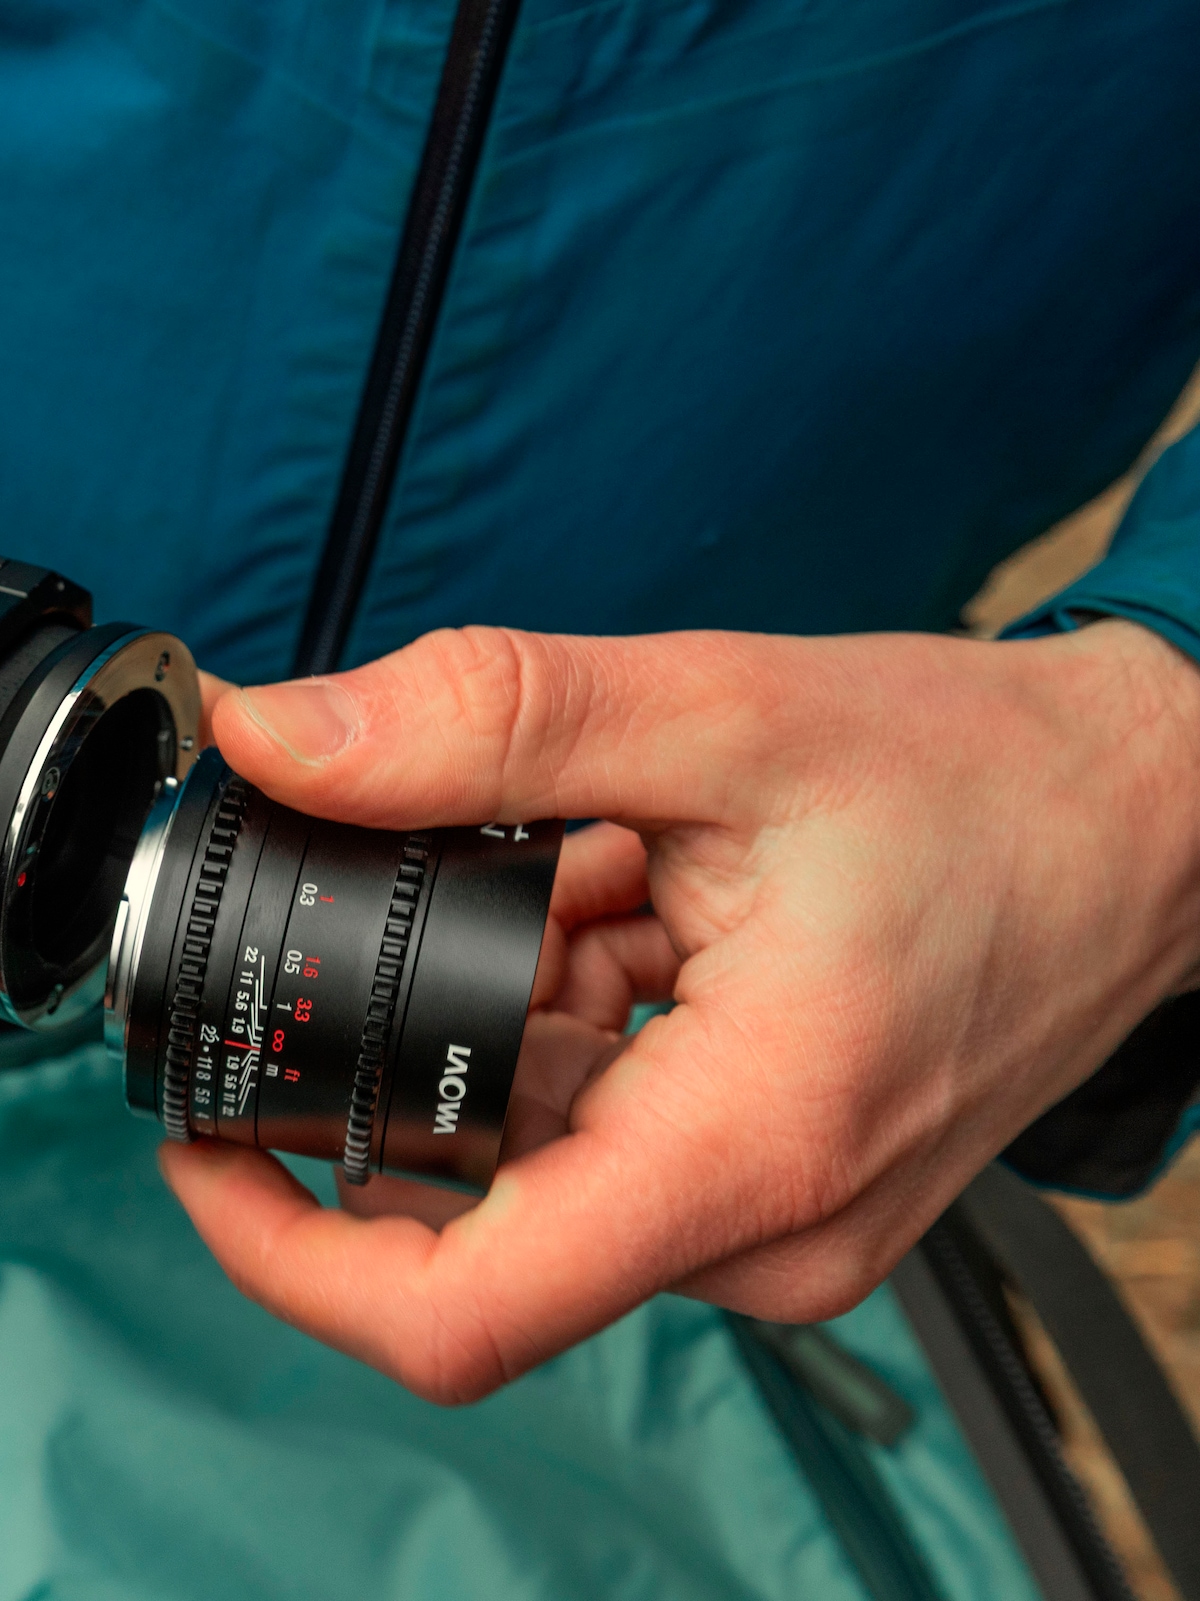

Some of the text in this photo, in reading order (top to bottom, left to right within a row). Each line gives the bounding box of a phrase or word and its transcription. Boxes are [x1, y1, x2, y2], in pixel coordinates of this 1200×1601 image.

[319, 895, 335, 903] 1
[244, 946, 259, 964] 22
[303, 955, 321, 979] 1.6
[240, 971, 254, 985] 11
[265, 883, 318, 1077] 0.3 0.5 1 m
[235, 990, 250, 1011] 5.6
[294, 998, 313, 1022] 3.3
[231, 1017, 246, 1034] 1.9
[197, 1056, 213, 1070] 11
[226, 1055, 240, 1071] 1.9
[196, 1071, 211, 1081] 8
[224, 1073, 237, 1090] 5.6
[284, 1068, 300, 1082] ft
[195, 1087, 210, 1104] 5.6
[223, 1092, 236, 1103] 11
